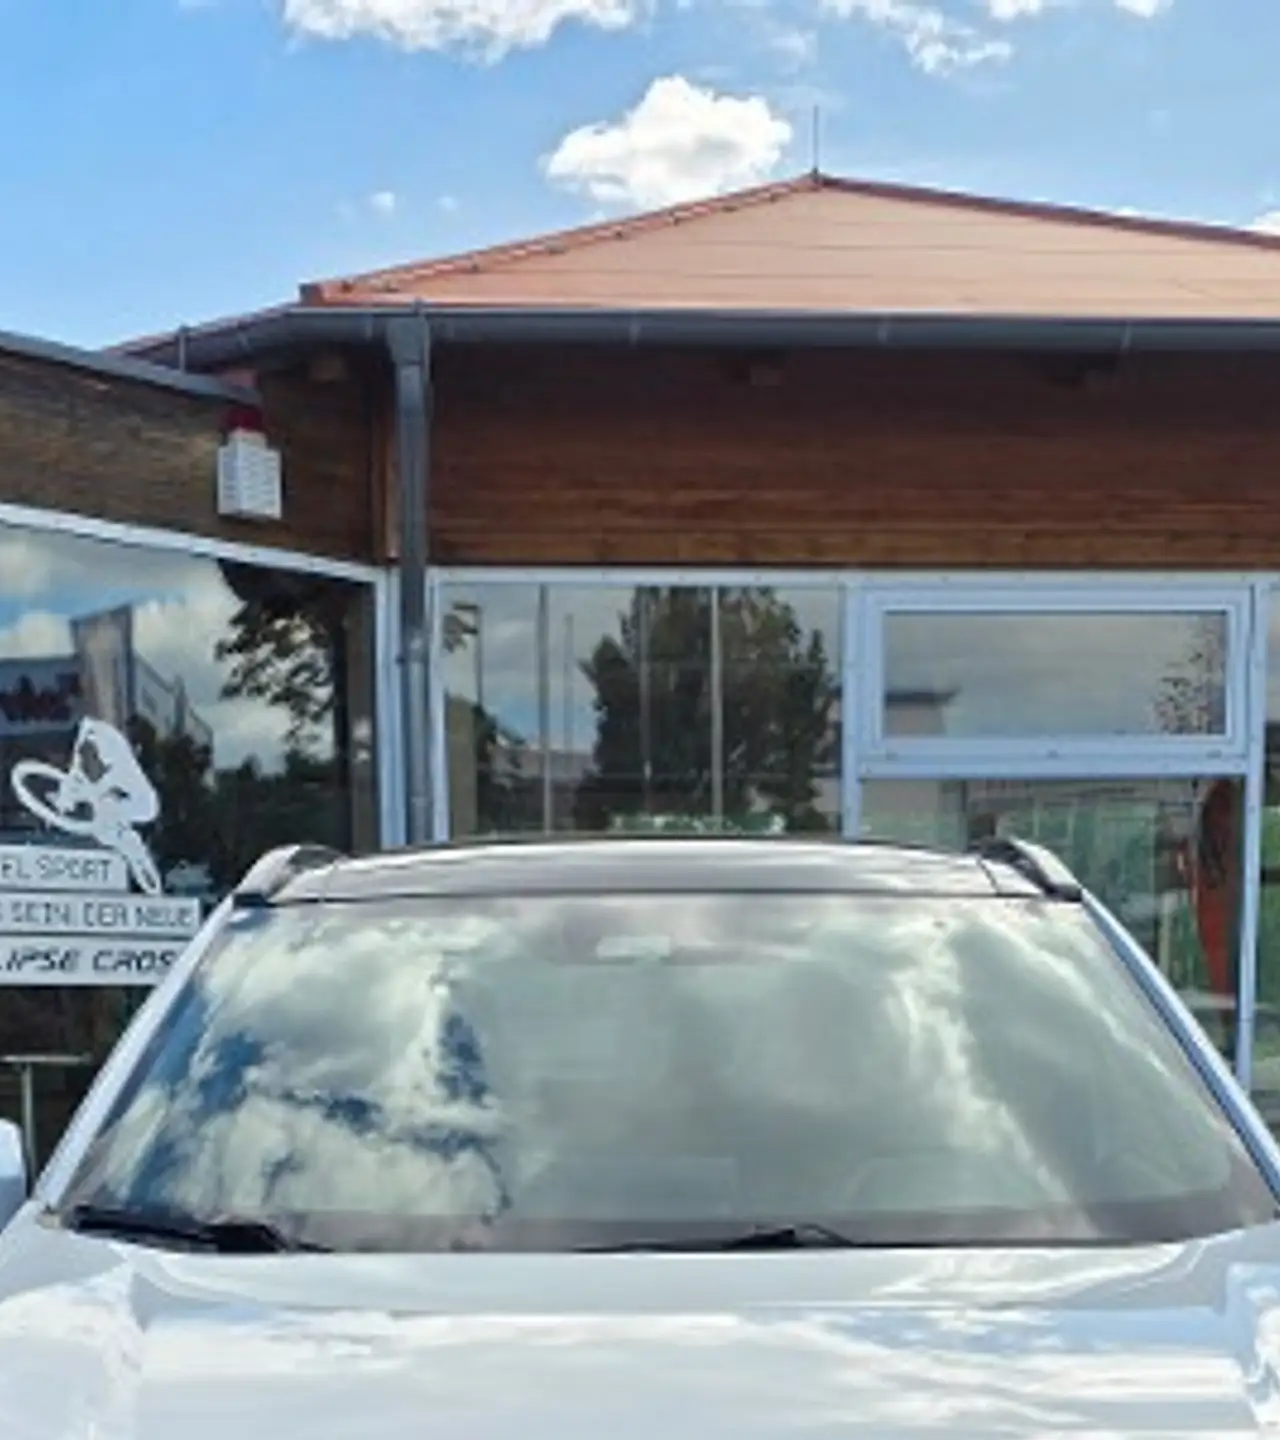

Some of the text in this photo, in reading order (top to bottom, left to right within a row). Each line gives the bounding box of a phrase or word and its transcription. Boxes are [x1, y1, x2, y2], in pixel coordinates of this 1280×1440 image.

[36, 855, 111, 882] SPORT
[83, 903, 128, 927] DER
[92, 950, 179, 974] CROS
